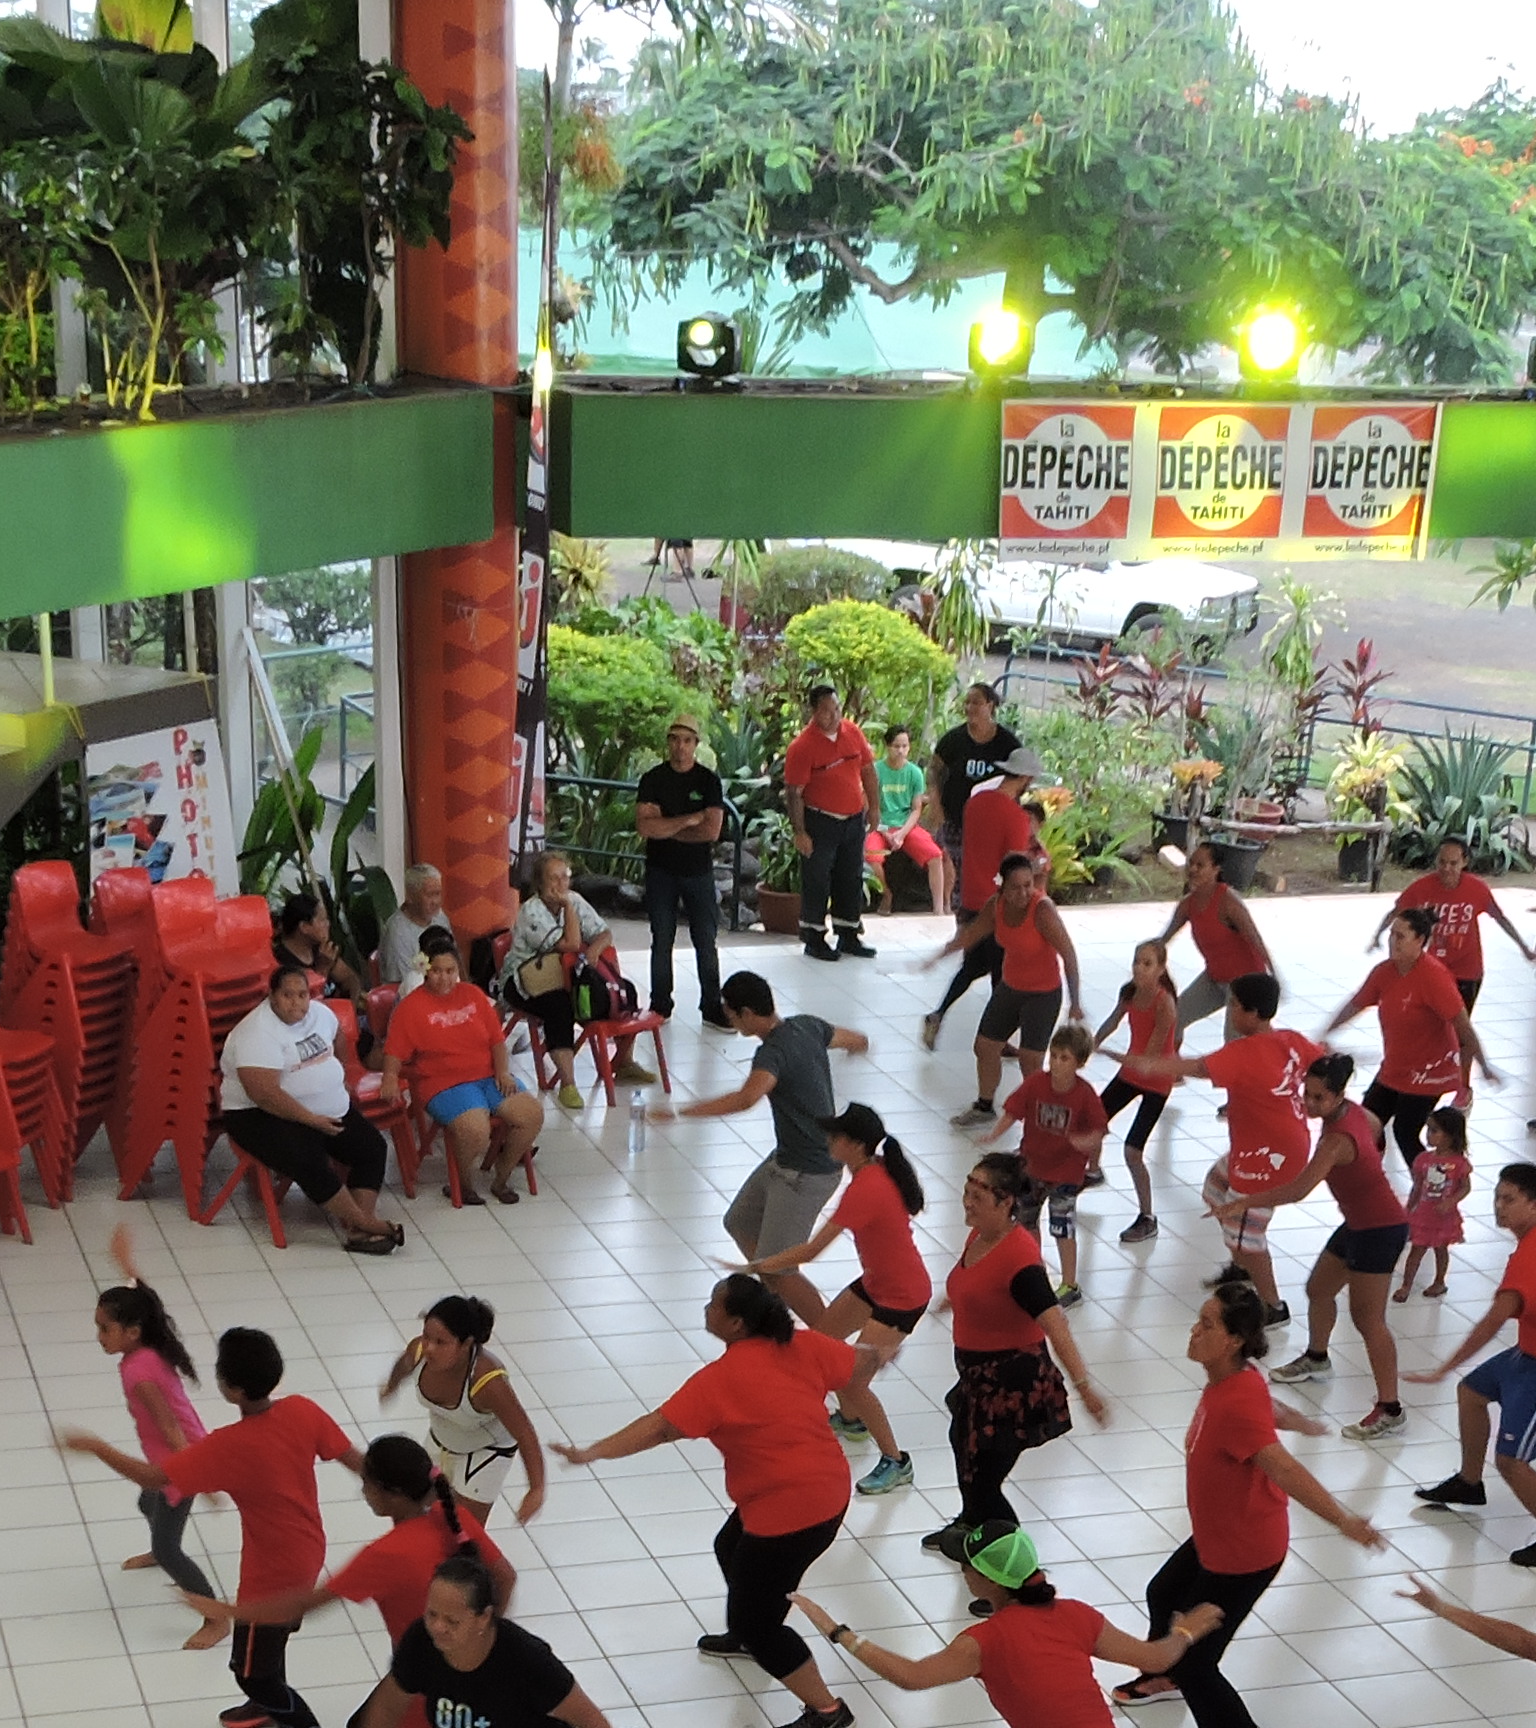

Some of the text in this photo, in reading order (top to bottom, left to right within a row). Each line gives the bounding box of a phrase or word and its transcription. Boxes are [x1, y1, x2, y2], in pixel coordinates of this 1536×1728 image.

[1060, 419, 1075, 438] la
[1217, 420, 1231, 438] la
[1367, 420, 1382, 438] la
[1056, 491, 1071, 503] de
[1212, 491, 1226, 503] de
[1361, 491, 1376, 503] de
[1034, 505, 1090, 520] TAHITI
[1190, 505, 1245, 520] TAHITI
[1339, 504, 1393, 519] TAHITI
